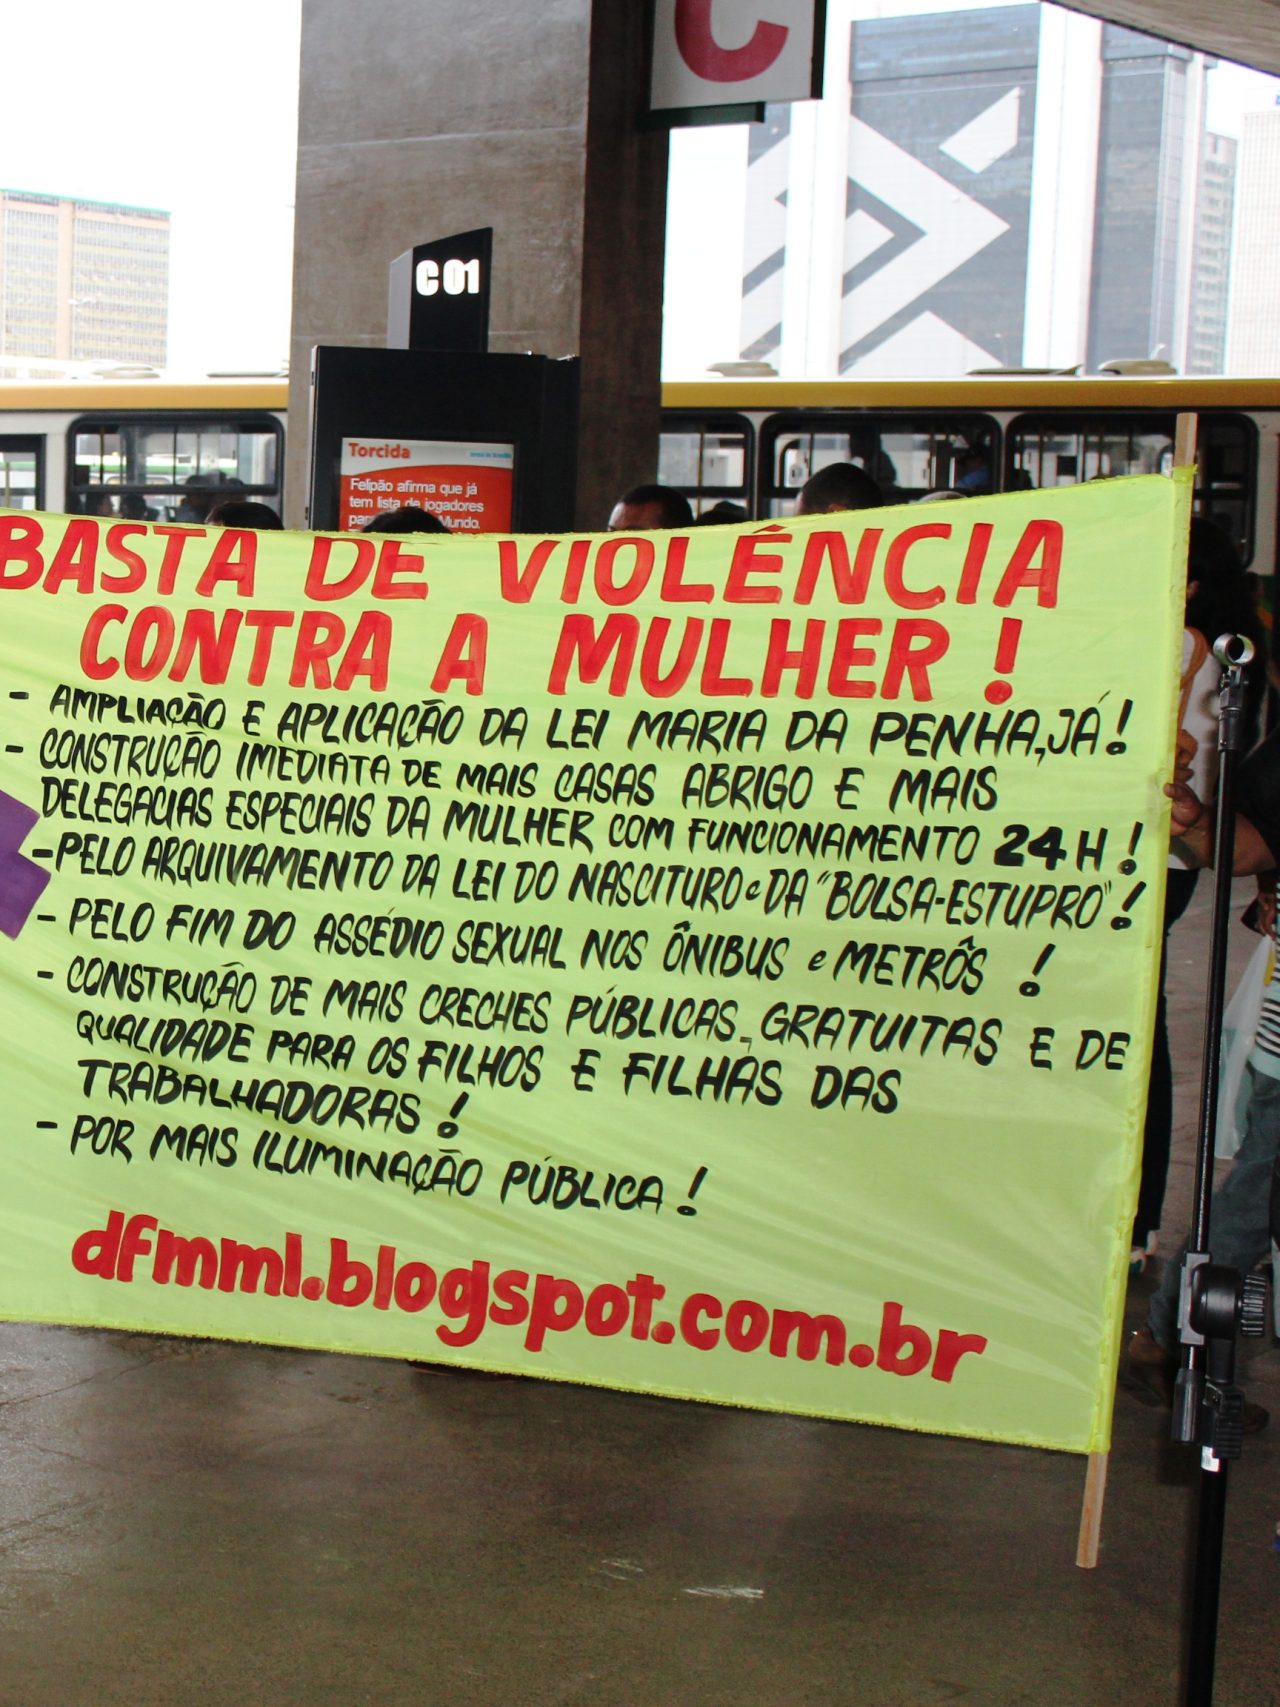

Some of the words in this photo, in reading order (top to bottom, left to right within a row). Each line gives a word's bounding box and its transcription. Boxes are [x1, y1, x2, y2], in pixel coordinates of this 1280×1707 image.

[348, 443, 410, 459] Torcida
[350, 478, 392, 493] Felipão
[397, 480, 436, 493] afirma
[440, 483, 463, 496] que
[466, 482, 478, 497] já
[349, 497, 373, 508] tem
[377, 496, 401, 509] lista
[424, 498, 484, 512] jogadores
[305, 536, 428, 601] DE
[499, 520, 1063, 610] VIOLÊNCIA
[81, 604, 392, 691] CONTRA
[432, 614, 487, 695] A
[548, 613, 949, 701] MULHER
[50, 684, 225, 734] AMPLIAÇÃO
[242, 701, 265, 736] E
[278, 699, 463, 748] APLICAÇÃO
[480, 707, 527, 749] DA
[547, 708, 609, 749] LEI
[628, 709, 767, 754] MARIA
[786, 709, 847, 753] DA
[40, 728, 220, 780] CONSTRUÇÃO
[237, 742, 390, 785] IMEDIATA
[402, 760, 441, 788] DE
[457, 763, 538, 797] MAIS
[555, 763, 656, 806] CASAS
[682, 763, 812, 811] ABRIGO
[835, 768, 864, 809] E
[889, 766, 997, 815] MAIS
[41, 777, 213, 829] DELEGACIAS
[226, 791, 374, 837] ESPECIAIS
[387, 796, 430, 840] DA
[443, 800, 594, 853] MULHER
[609, 814, 674, 850] COM
[689, 818, 980, 865] FUNCIONAMENTO
[142, 836, 393, 891] ARQUIVAMENTO
[402, 854, 440, 897] DA
[453, 859, 506, 901] LEI
[514, 861, 558, 903] DO
[569, 860, 743, 912] NASCITURO
[764, 869, 808, 917] DA
[70, 898, 154, 942] PELO
[167, 905, 234, 947] FIM
[243, 910, 296, 950] DO
[314, 907, 444, 960] ASSÉDIO
[452, 920, 566, 969] SEXUAL
[581, 929, 648, 970] NOS
[663, 921, 789, 980] ÔNIBUS
[833, 936, 987, 995] METRÔS
[67, 956, 256, 1013] CONSTRUÇÃO
[271, 975, 312, 1015] DE
[323, 979, 407, 1022] MAIS
[420, 984, 551, 1033] CRECHES
[761, 1002, 1002, 1066] GRATUITAS
[1030, 1027, 1054, 1070] E
[1076, 1030, 1130, 1070] DE
[77, 1010, 254, 1062] QUALIDADE
[267, 1030, 355, 1070] PARA
[368, 1037, 409, 1078] OS
[418, 1041, 543, 1092] FILHOS
[571, 1049, 600, 1091] E
[623, 1053, 782, 1105] FILHAS
[811, 1066, 900, 1114] DAS
[77, 1060, 420, 1135] TRABALHADORAS
[71, 1115, 134, 1163] POR
[150, 1124, 238, 1167] MAIS
[253, 1130, 482, 1196] ILUMINAÇÃO
[501, 1156, 663, 1213] PÚBLICA
[73, 1211, 986, 1381] dfmml.blogspot.com.br
